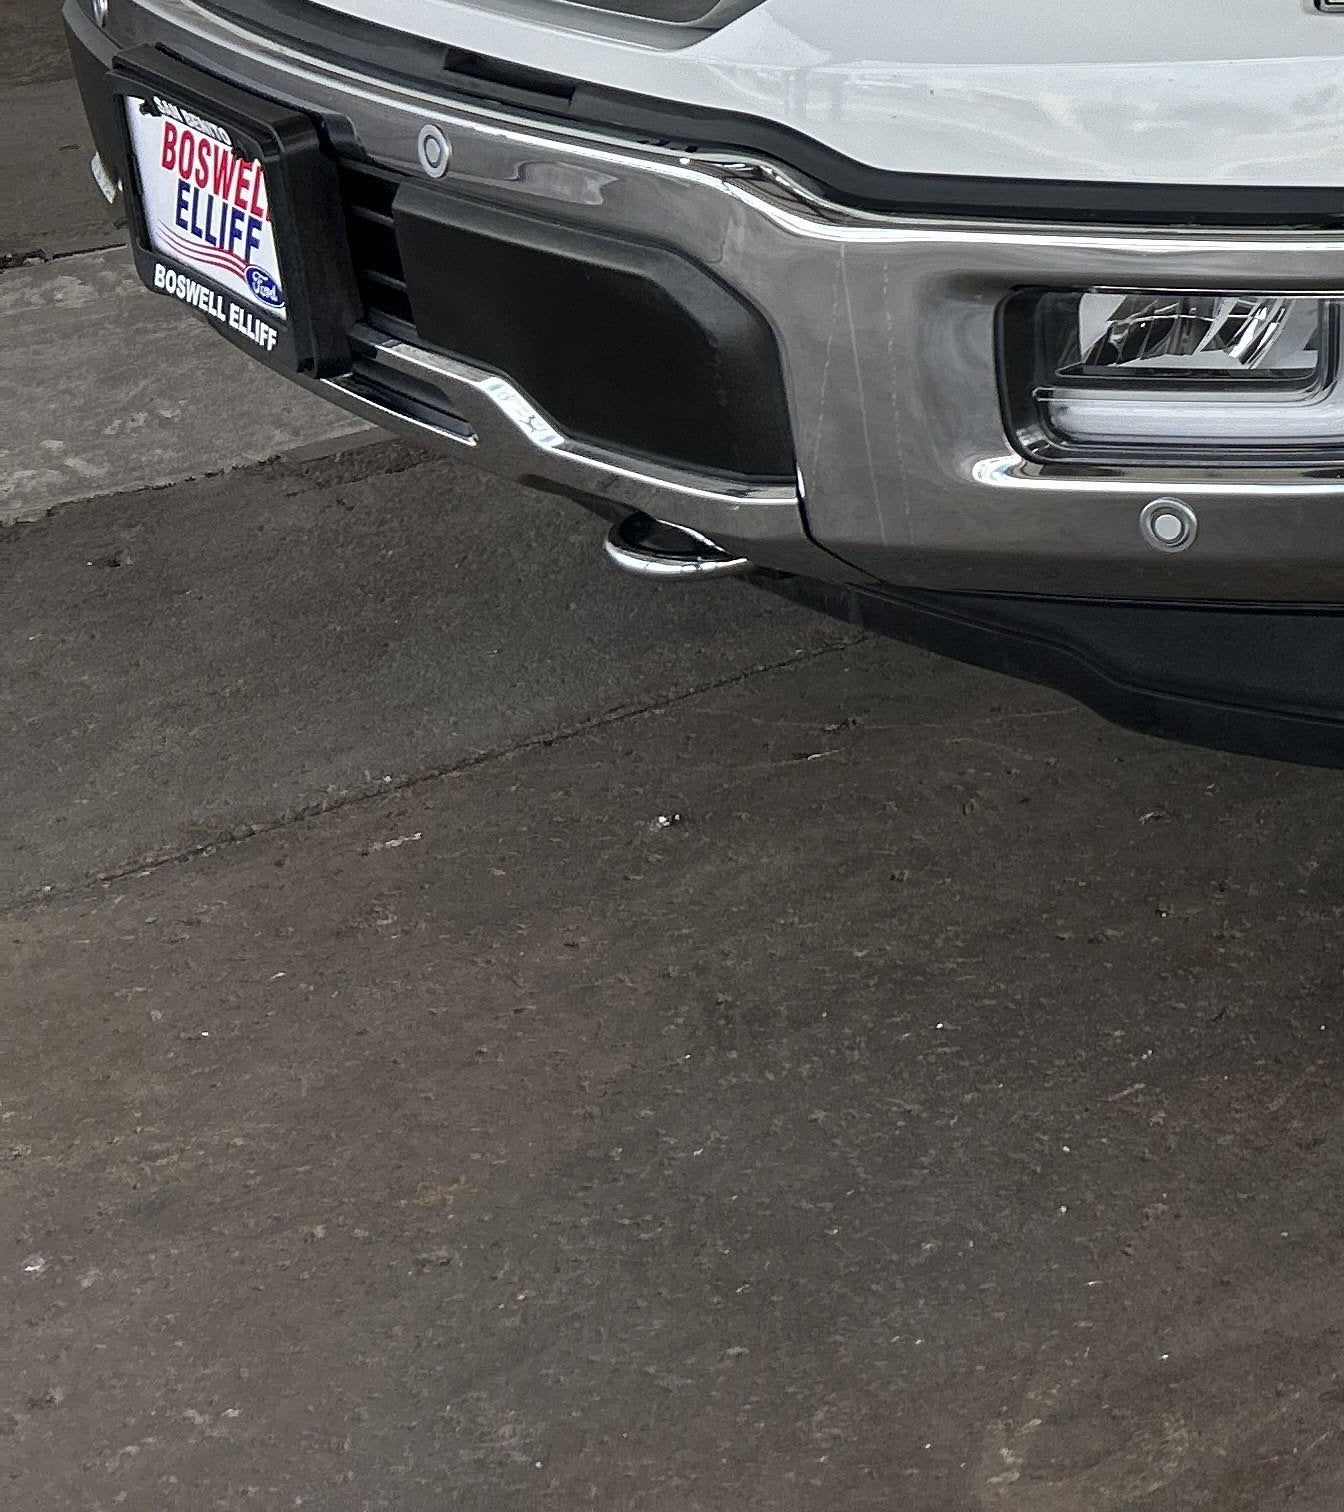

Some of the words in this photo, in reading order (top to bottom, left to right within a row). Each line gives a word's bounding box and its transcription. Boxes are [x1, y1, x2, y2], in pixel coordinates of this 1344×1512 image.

[176, 178, 263, 264] ELLIFF
[154, 263, 226, 322] BOSWELL
[229, 302, 278, 351] ELLIFF
